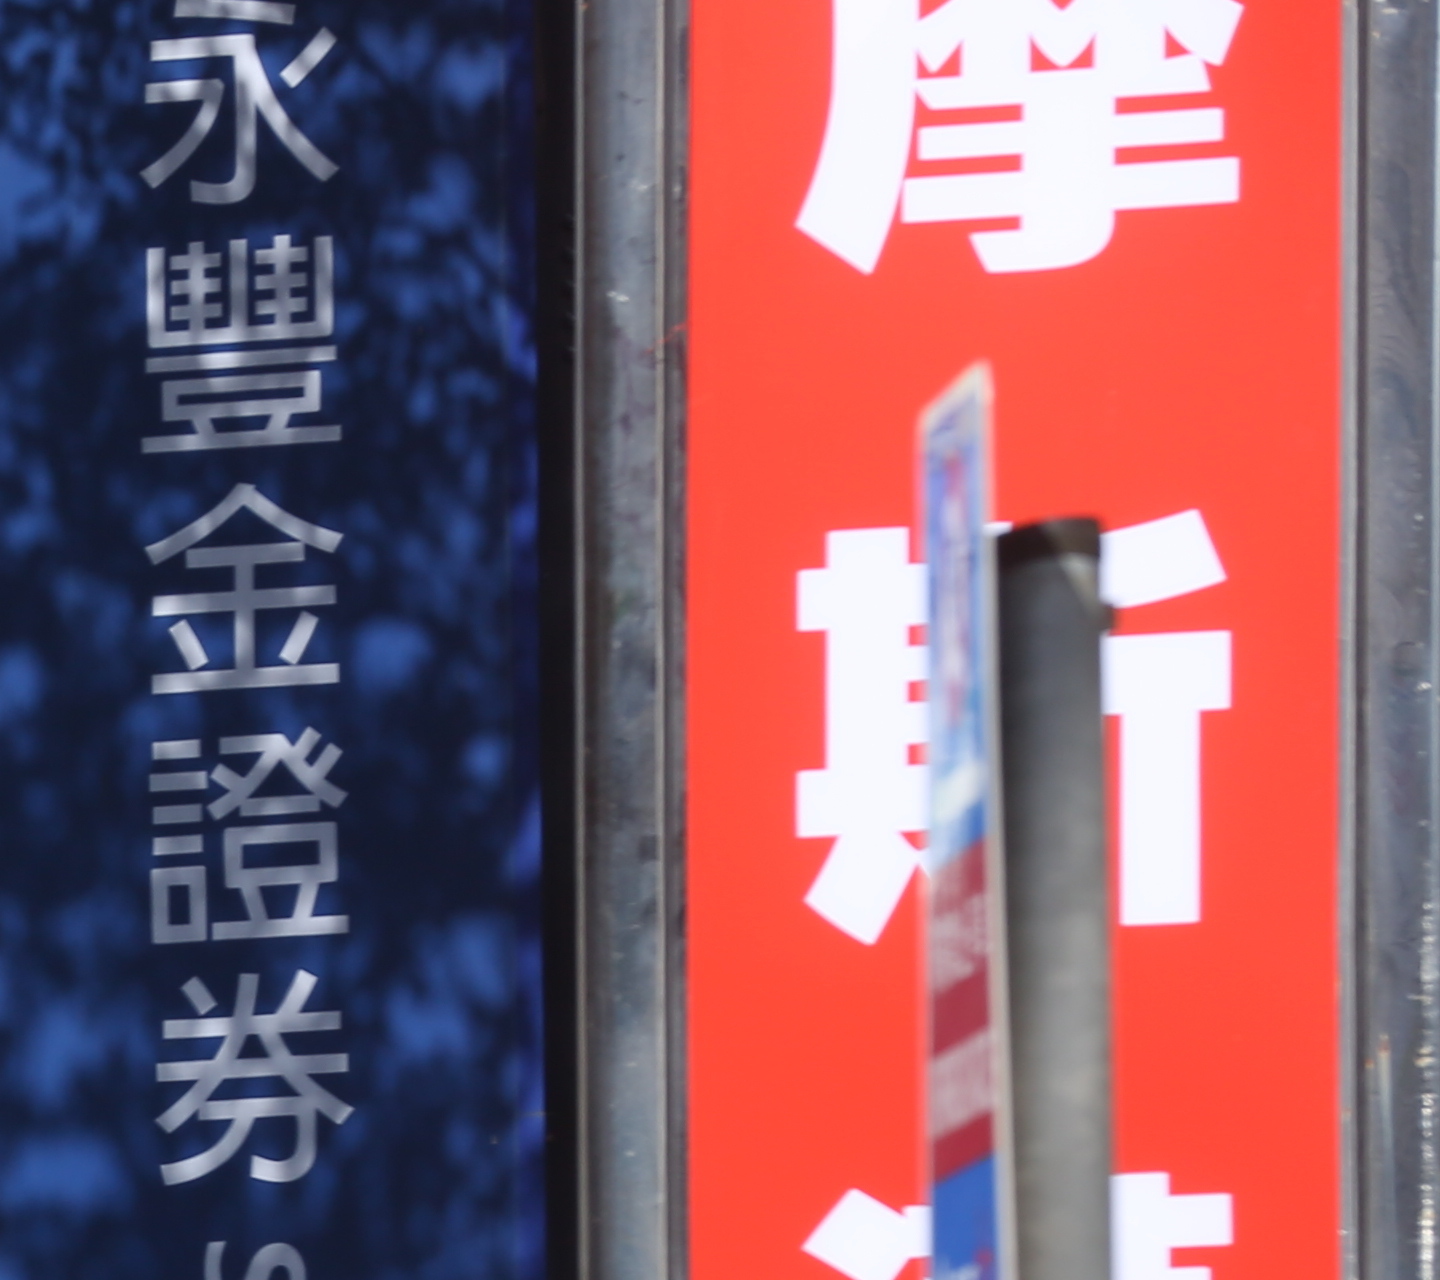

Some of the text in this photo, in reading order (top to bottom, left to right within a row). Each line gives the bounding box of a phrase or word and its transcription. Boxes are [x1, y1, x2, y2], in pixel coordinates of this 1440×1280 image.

[139, 0, 356, 1187] 永豐金證券
